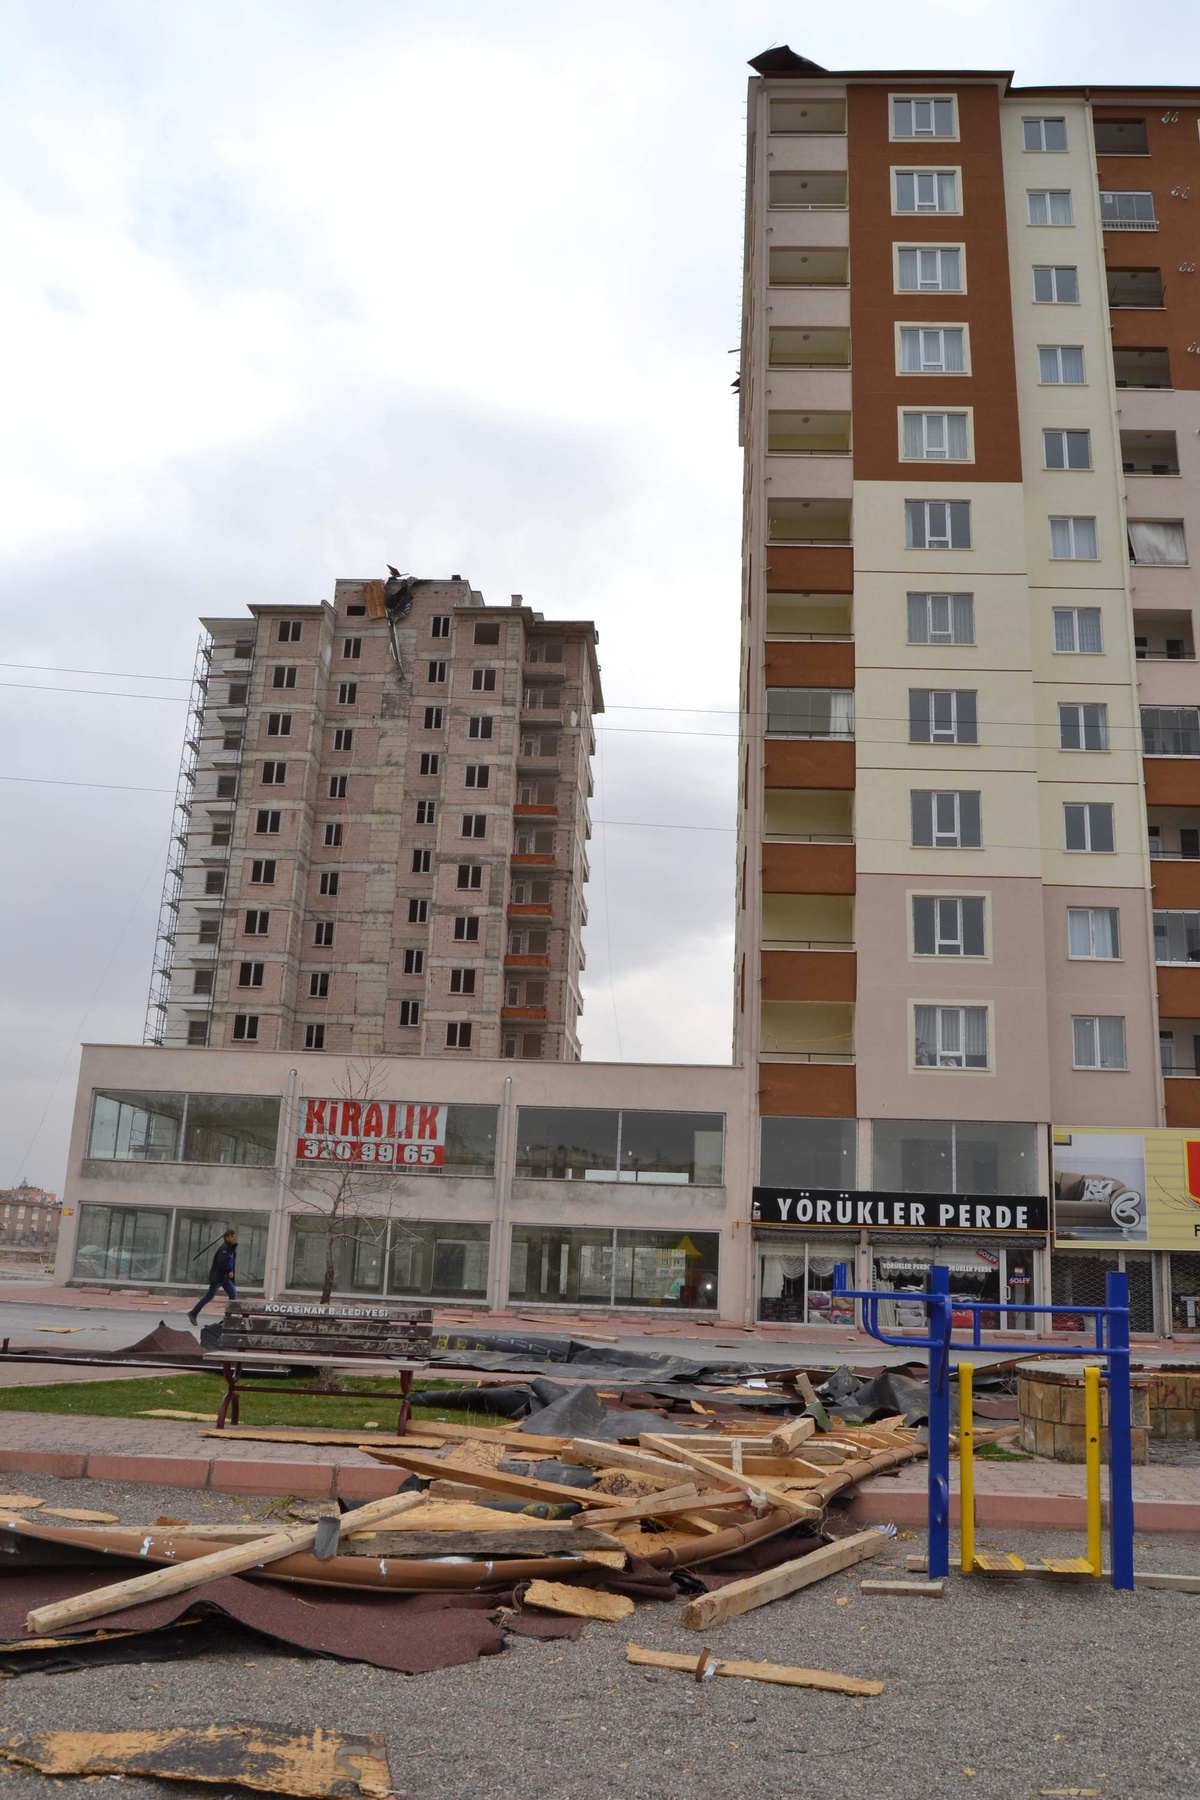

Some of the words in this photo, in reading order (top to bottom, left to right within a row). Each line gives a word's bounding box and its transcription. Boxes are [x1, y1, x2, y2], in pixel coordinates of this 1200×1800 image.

[303, 1139, 352, 1160] 320
[360, 1142, 394, 1162] 99
[403, 1144, 436, 1164] 65
[776, 1191, 926, 1227] YÖRÜKLER
[939, 1203, 1029, 1230] PERDE
[882, 1261, 912, 1271] YÖRÜKLER
[974, 1265, 992, 1274] PERDE
[328, 1307, 389, 1318] BLEDİYESİ
